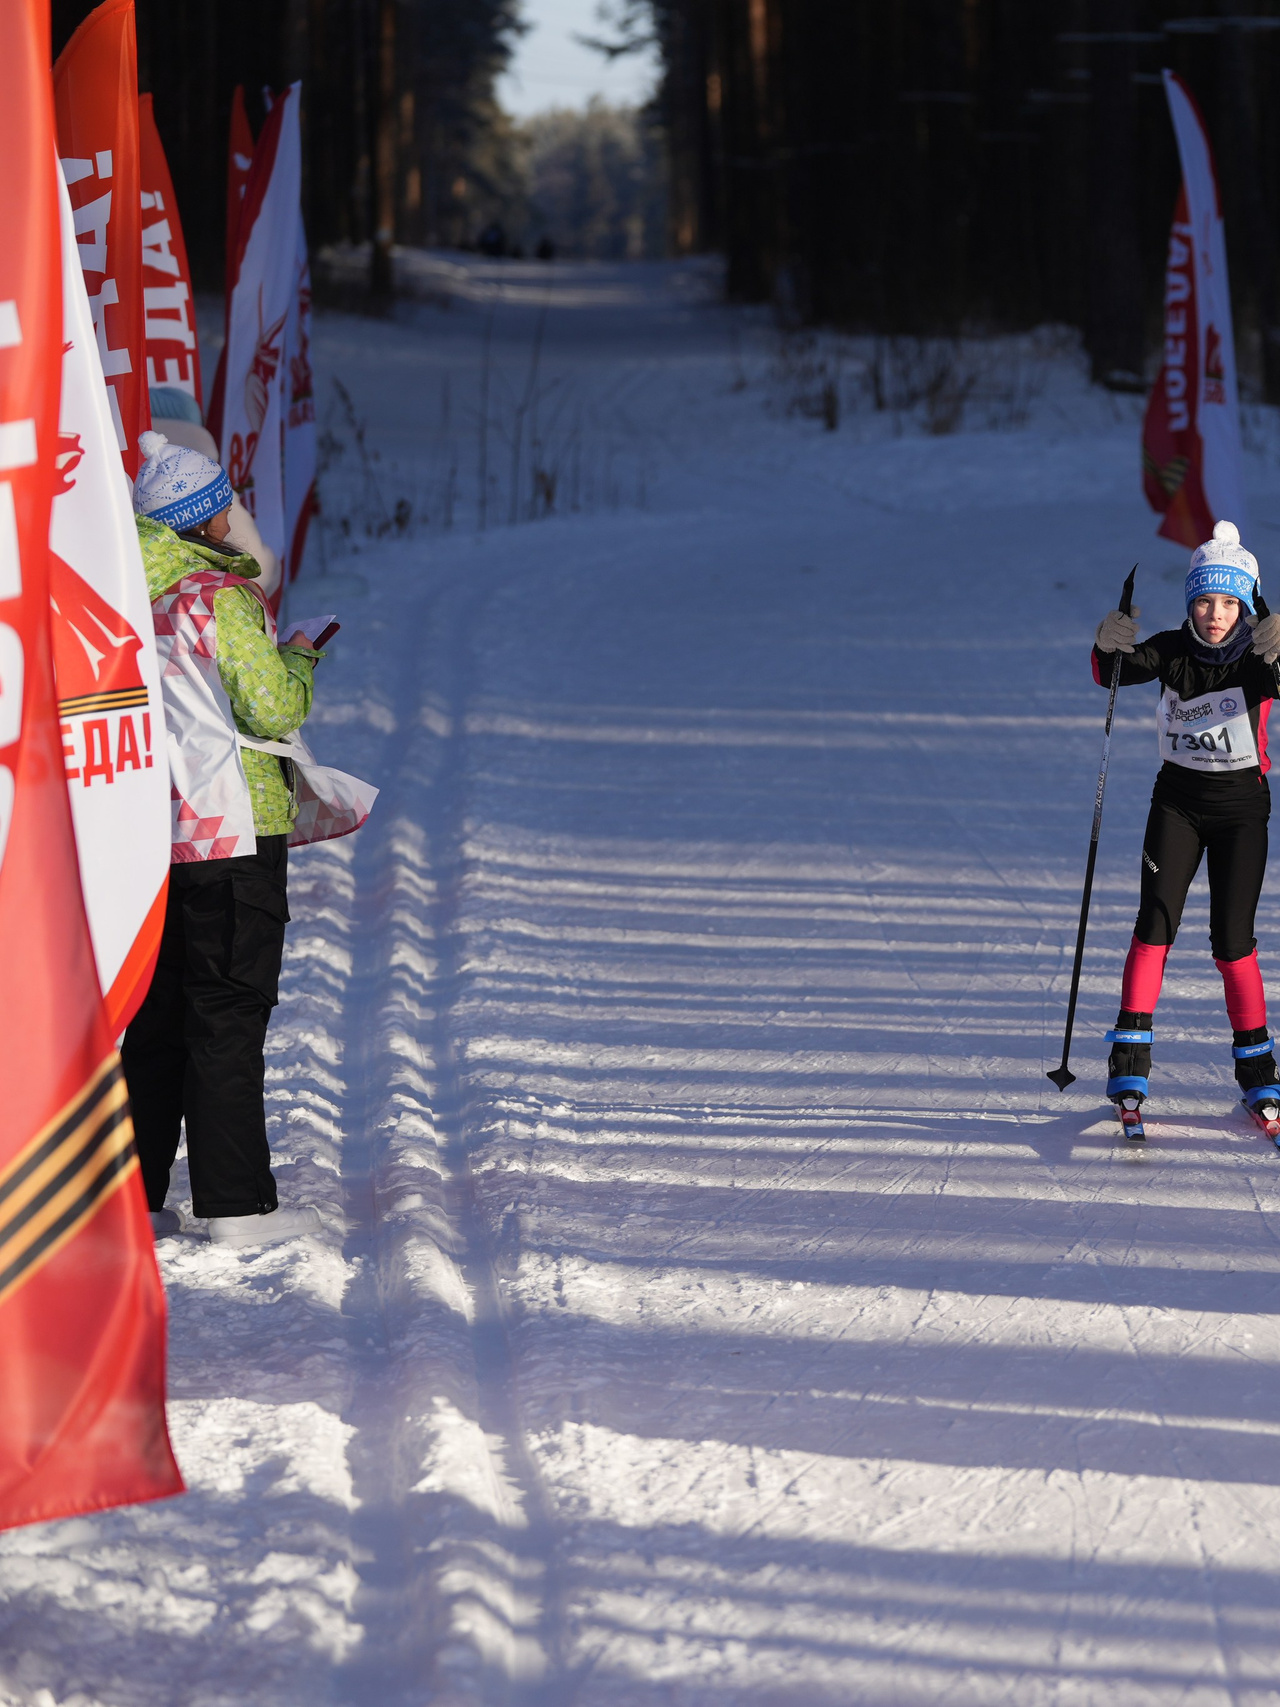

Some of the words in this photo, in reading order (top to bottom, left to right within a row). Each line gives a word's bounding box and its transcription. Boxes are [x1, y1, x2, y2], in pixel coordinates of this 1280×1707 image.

[160, 497, 213, 528] ЫЖНЯ
[1186, 572, 1231, 592] ОССИИ
[1175, 708, 1213, 722] РОССИИ
[1176, 703, 1211, 716] ЛЫЖНЯ
[1166, 727, 1233, 754] 7301
[1244, 1044, 1271, 1055] SPINE
